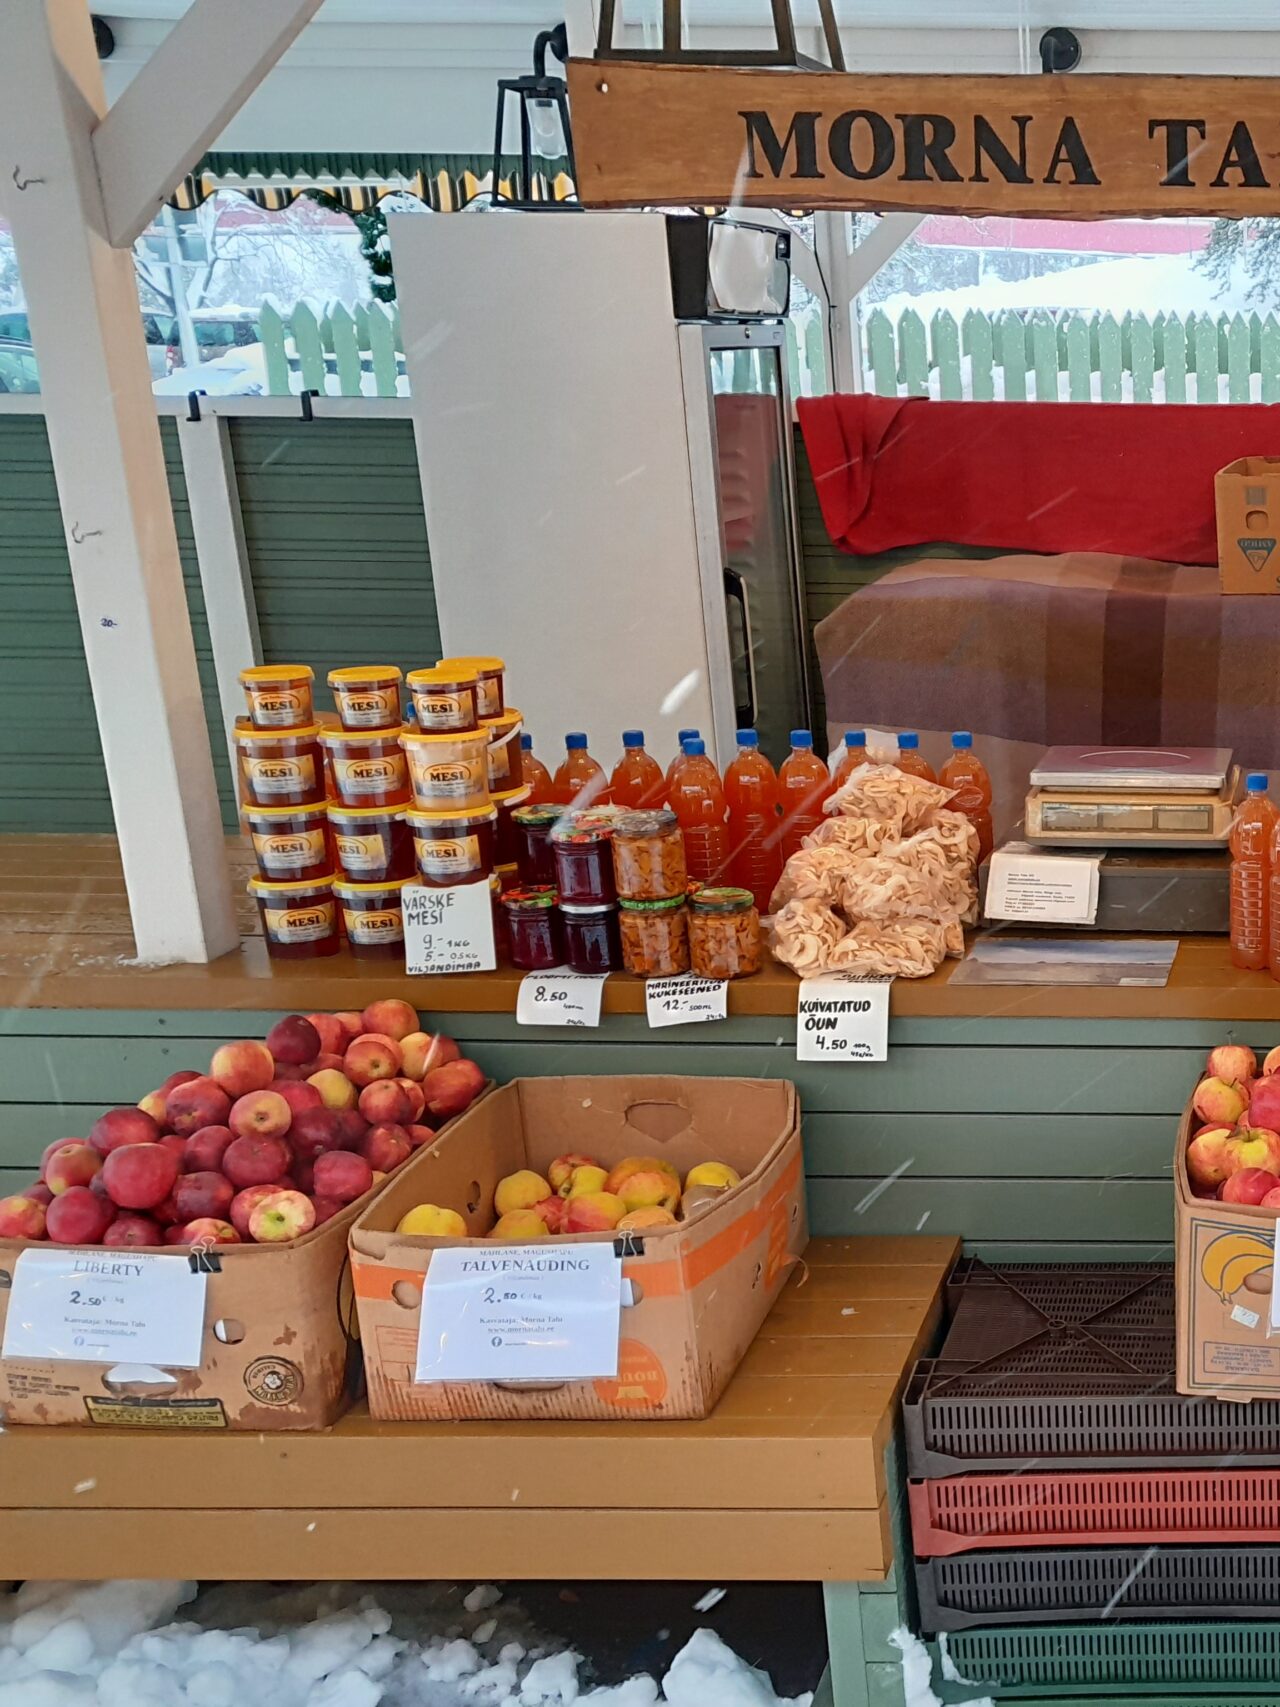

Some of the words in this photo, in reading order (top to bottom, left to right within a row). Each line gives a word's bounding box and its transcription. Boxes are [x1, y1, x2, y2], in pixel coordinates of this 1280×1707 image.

[738, 109, 1101, 185] MORNA
[258, 700, 293, 711] MESI
[345, 700, 380, 711] MESI
[421, 703, 453, 713] MESI
[258, 767, 293, 778] MESI
[352, 766, 388, 778] MESI
[430, 771, 465, 782] MESI
[269, 842, 304, 854] MESI
[425, 847, 457, 858] MESI
[403, 890, 456, 911] VÄRSKE
[286, 915, 320, 927] MESI
[407, 909, 443, 926] MESI
[359, 918, 394, 930] MESI
[534, 985, 568, 1002] 8.50
[648, 984, 722, 1000] KUKESEENED
[799, 998, 871, 1014] KUIVATATUD
[804, 1013, 838, 1031] ÕUN
[816, 1034, 847, 1050] 4.50
[73, 1260, 144, 1276] LIBERTY
[461, 1259, 591, 1272] TALVENAUDING
